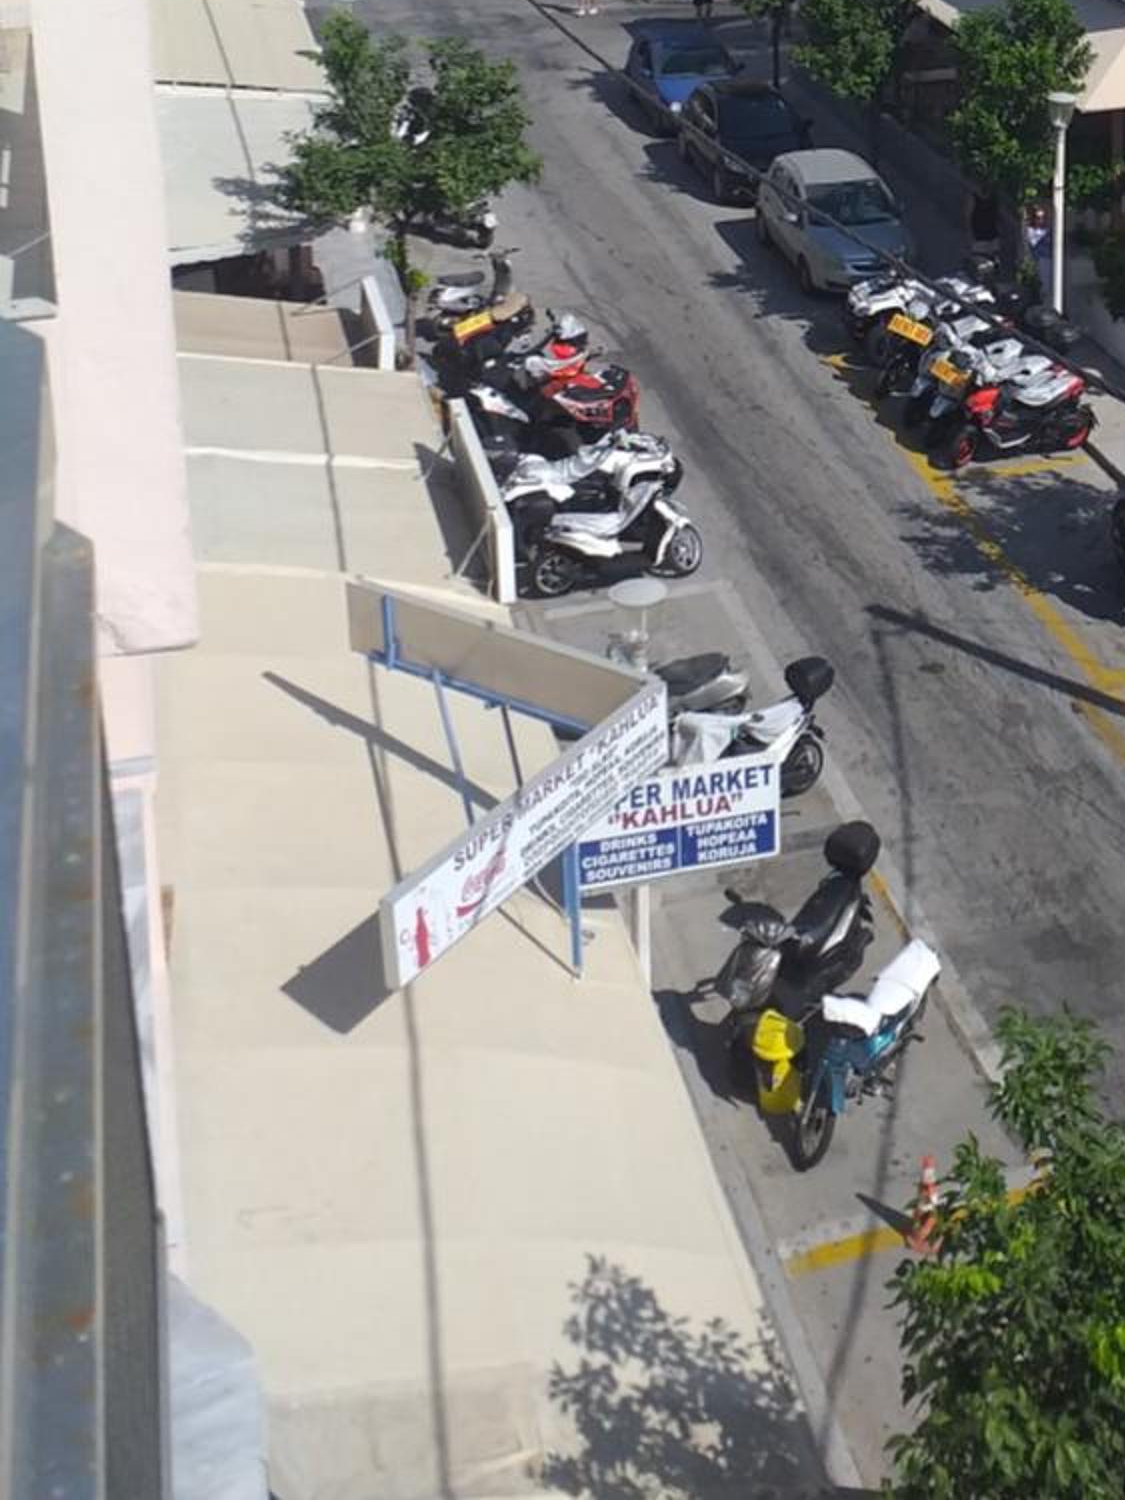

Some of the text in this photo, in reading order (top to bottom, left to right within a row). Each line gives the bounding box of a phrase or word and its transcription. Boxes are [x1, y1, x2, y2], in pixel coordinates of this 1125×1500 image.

[614, 783, 661, 810] PER
[672, 764, 774, 802] MARKET
[686, 812, 768, 837] TUPAKOITA
[453, 813, 514, 872] SUPER
[600, 833, 658, 853] DRINKS
[697, 828, 757, 849] HOPEAA
[582, 842, 675, 870] CIGARETTES
[697, 846, 757, 863] KORUJA
[586, 857, 672, 882] SOUVENIRS
